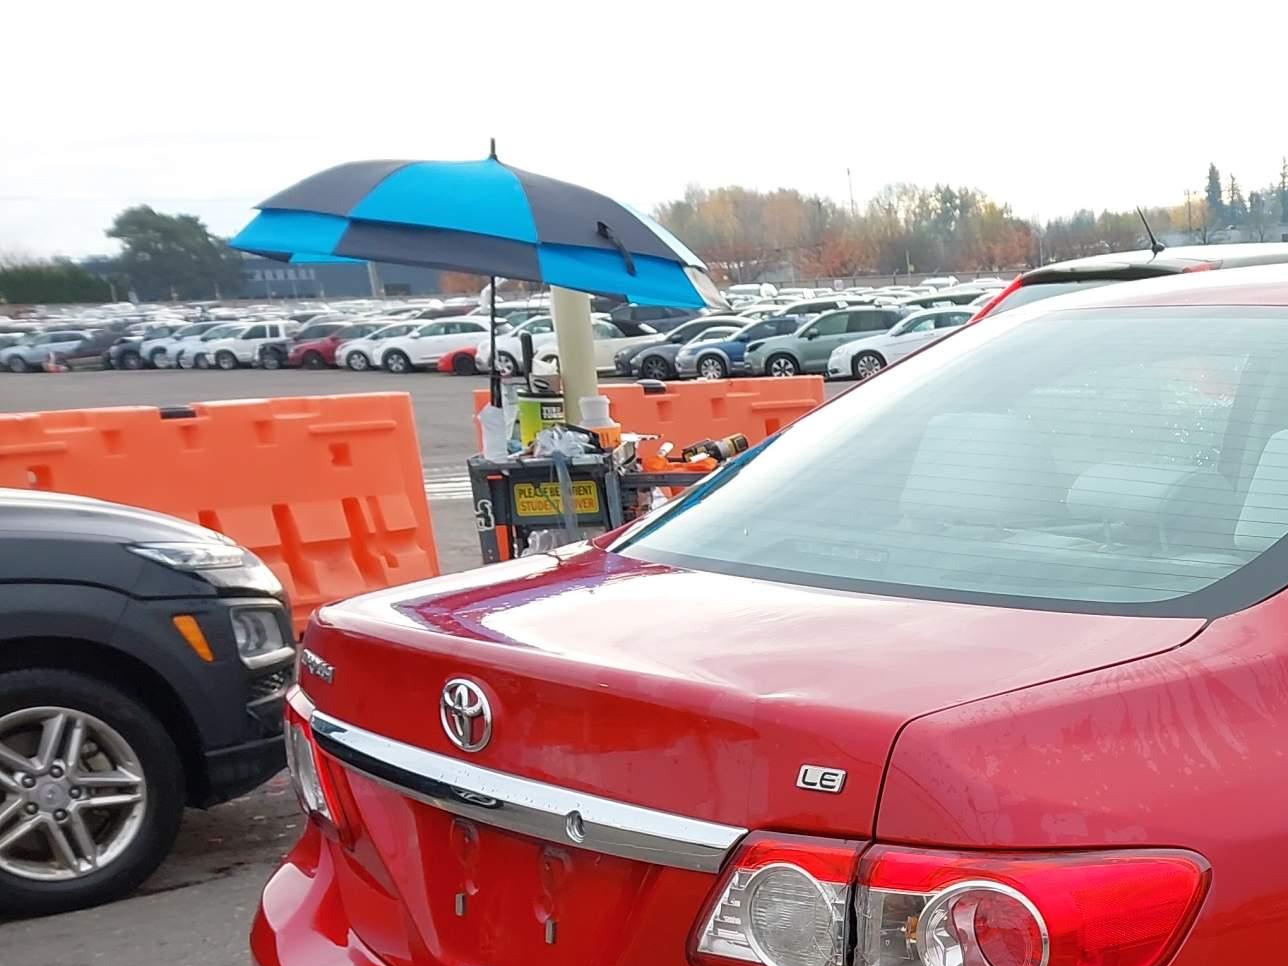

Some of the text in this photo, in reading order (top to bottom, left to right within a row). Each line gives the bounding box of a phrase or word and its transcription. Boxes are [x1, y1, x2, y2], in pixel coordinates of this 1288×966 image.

[517, 486, 550, 499] PLEAE
[520, 500, 560, 512] STUDE
[800, 767, 841, 790] LE
